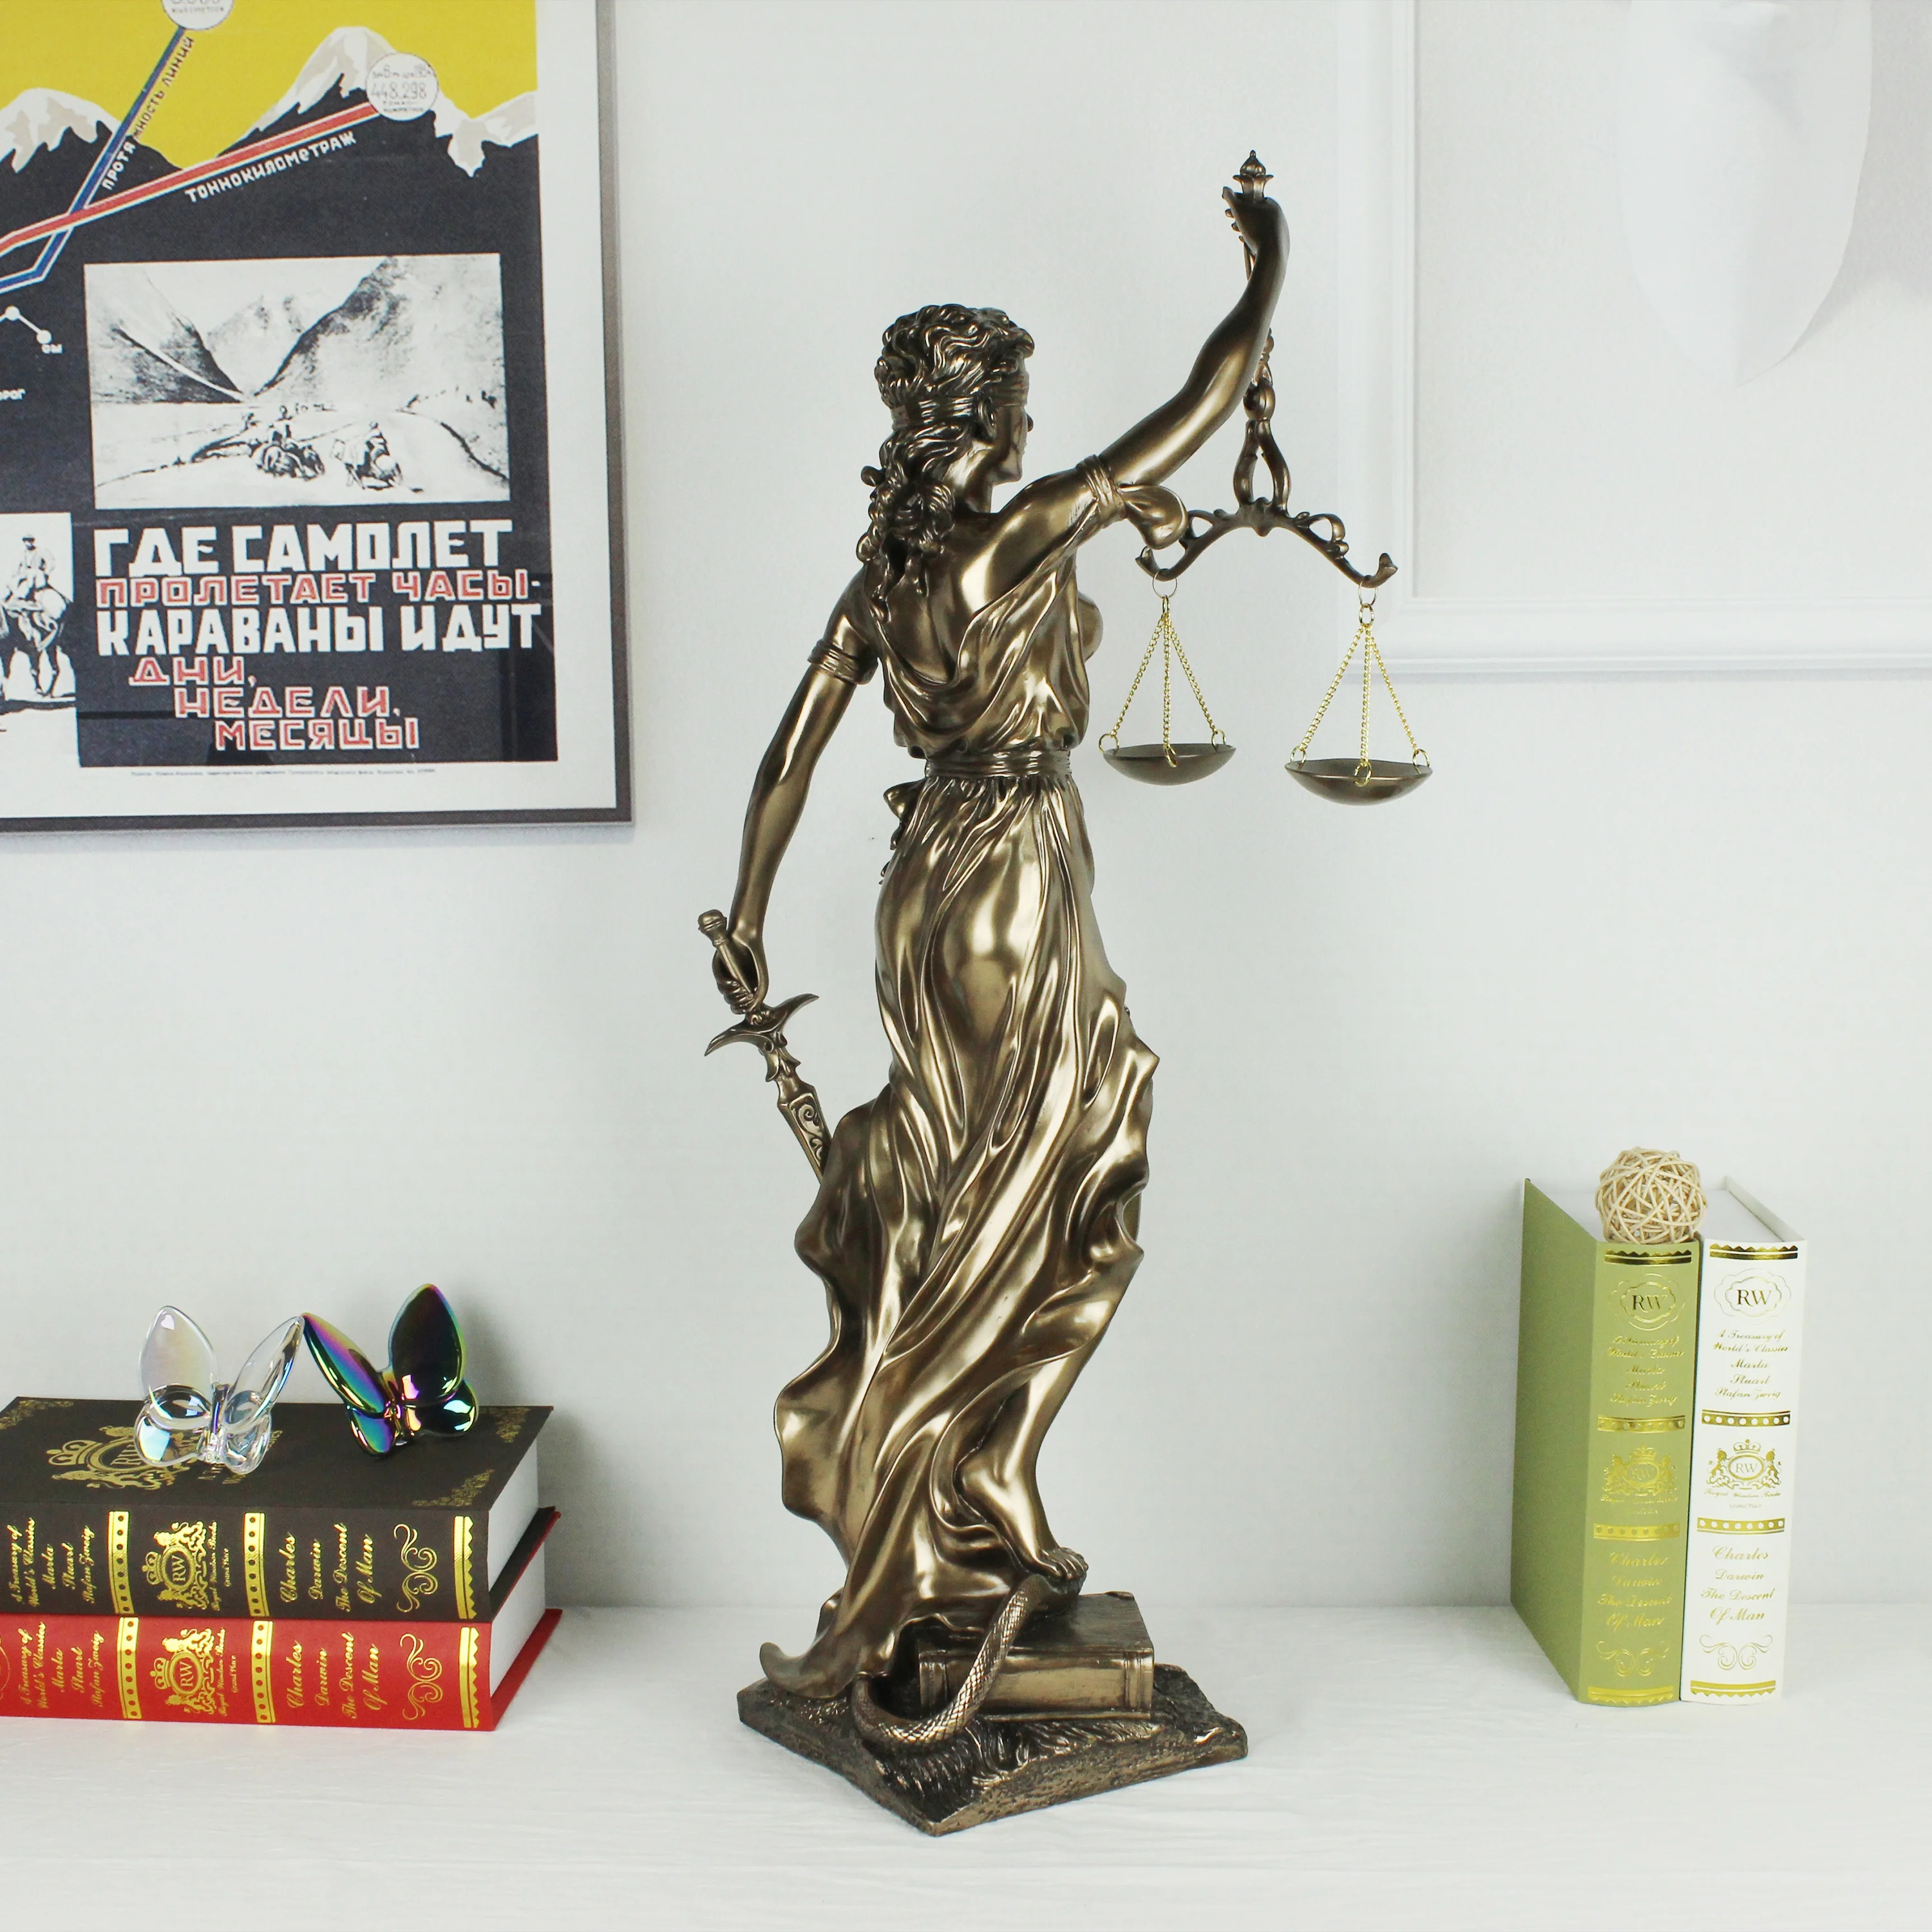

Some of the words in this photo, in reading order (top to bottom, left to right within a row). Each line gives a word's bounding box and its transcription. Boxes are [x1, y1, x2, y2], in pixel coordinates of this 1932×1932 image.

[93, 526, 219, 578] ГДЕ
[231, 519, 513, 574] САМОЛЕТ
[96, 573, 376, 608] ПРОЛЕТАЕТ
[97, 606, 383, 656] КАРАВАНЫ
[399, 603, 542, 652] ИДУТ
[129, 656, 258, 687] ДНИ,
[215, 716, 419, 751] МЕСЯЦЫ
[1632, 1294, 1668, 1313] RW
[1736, 1289, 1772, 1307] RW
[1728, 1330, 1772, 1342] Treasury
[1775, 1329, 1785, 1342] of
[1736, 1463, 1757, 1473] RW
[6, 1524, 23, 1540] of
[332, 1522, 348, 1584] Descent
[355, 1533, 374, 1583] Man
[1712, 1546, 1768, 1559] Charles
[8, 1542, 22, 1593] Treasury
[171, 1555, 187, 1581] RW
[278, 1531, 298, 1603] Charles
[307, 1538, 323, 1600] Darwin
[1715, 1569, 1764, 1580] Darwin
[335, 1588, 351, 1612] The
[356, 1581, 382, 1604] Of
[1701, 1587, 1725, 1599] The
[1730, 1587, 1776, 1600] Descent
[1710, 1606, 1731, 1625] Of
[1730, 1607, 1765, 1621] Man
[17, 1628, 33, 1644] of
[18, 1646, 32, 1695] Treasury
[179, 1661, 194, 1687] RW
[286, 1640, 303, 1709] Charles
[338, 1631, 355, 1692] Descent
[362, 1643, 381, 1691] Man
[314, 1647, 330, 1706] Darwin
[342, 1696, 357, 1719] The
[363, 1689, 388, 1710] Of
